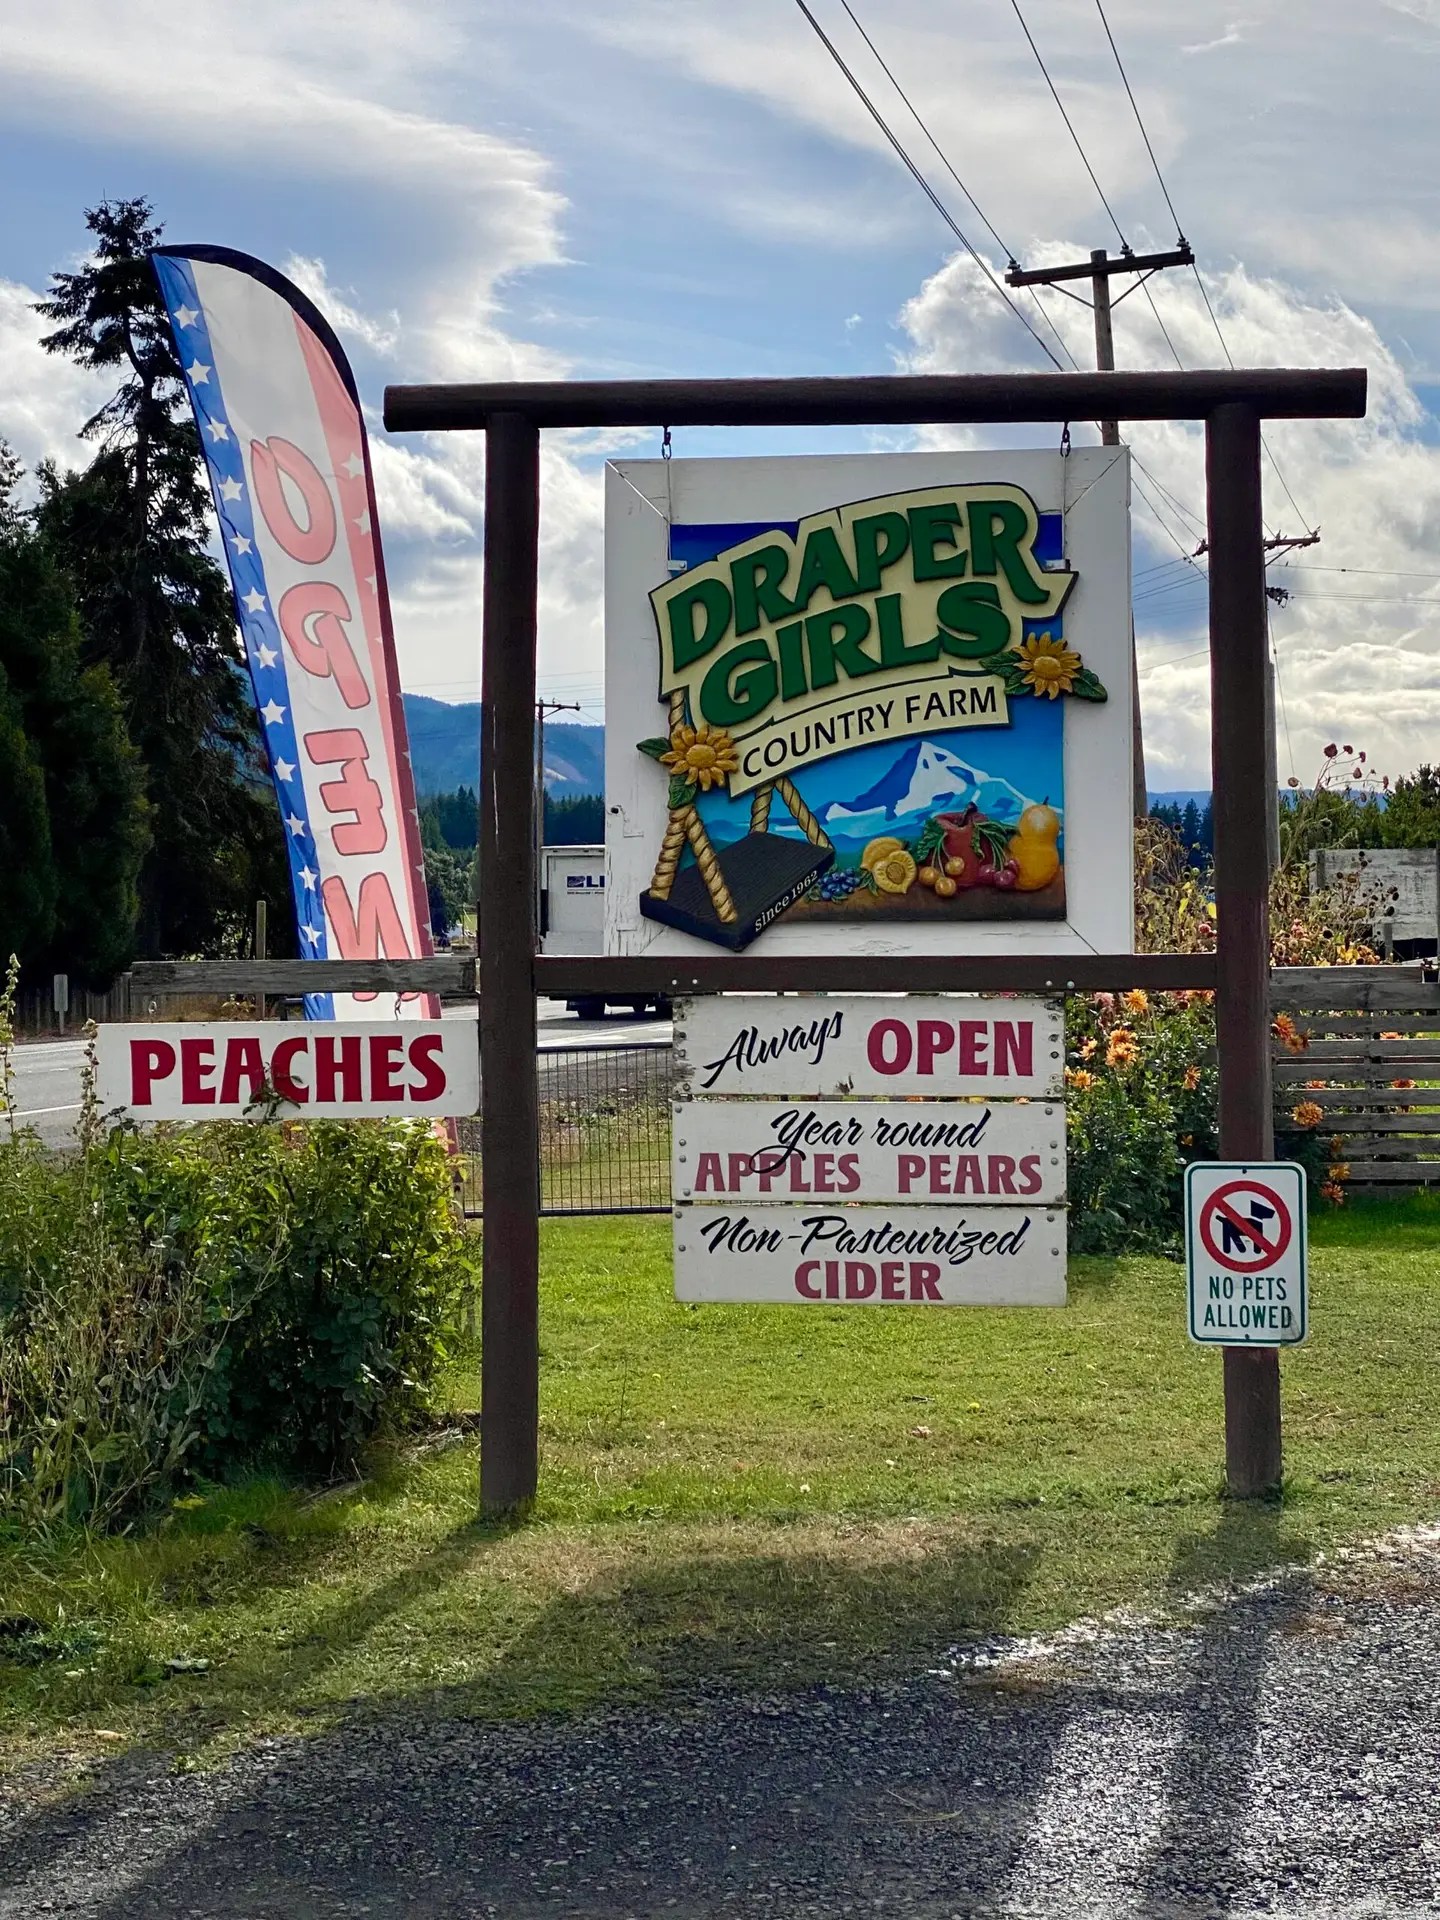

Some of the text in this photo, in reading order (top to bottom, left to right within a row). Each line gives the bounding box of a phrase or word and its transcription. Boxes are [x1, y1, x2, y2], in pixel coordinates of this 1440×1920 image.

[666, 500, 1050, 674] DRAPER
[699, 580, 1011, 727] GIRLS
[742, 686, 998, 778] COUNTRY FARM
[754, 869, 829, 933] since 1962
[129, 1034, 447, 1106] PEACHES
[700, 1010, 1034, 1089] Always OPEN
[693, 1152, 1042, 1195] APPLES PEARS
[749, 1108, 992, 1174] Year round
[700, 1215, 1031, 1266] Non-Pasteurized
[794, 1260, 944, 1300] CIDER
[1209, 1276, 1287, 1301] NO PETS
[1203, 1303, 1292, 1329] ALLOWED
